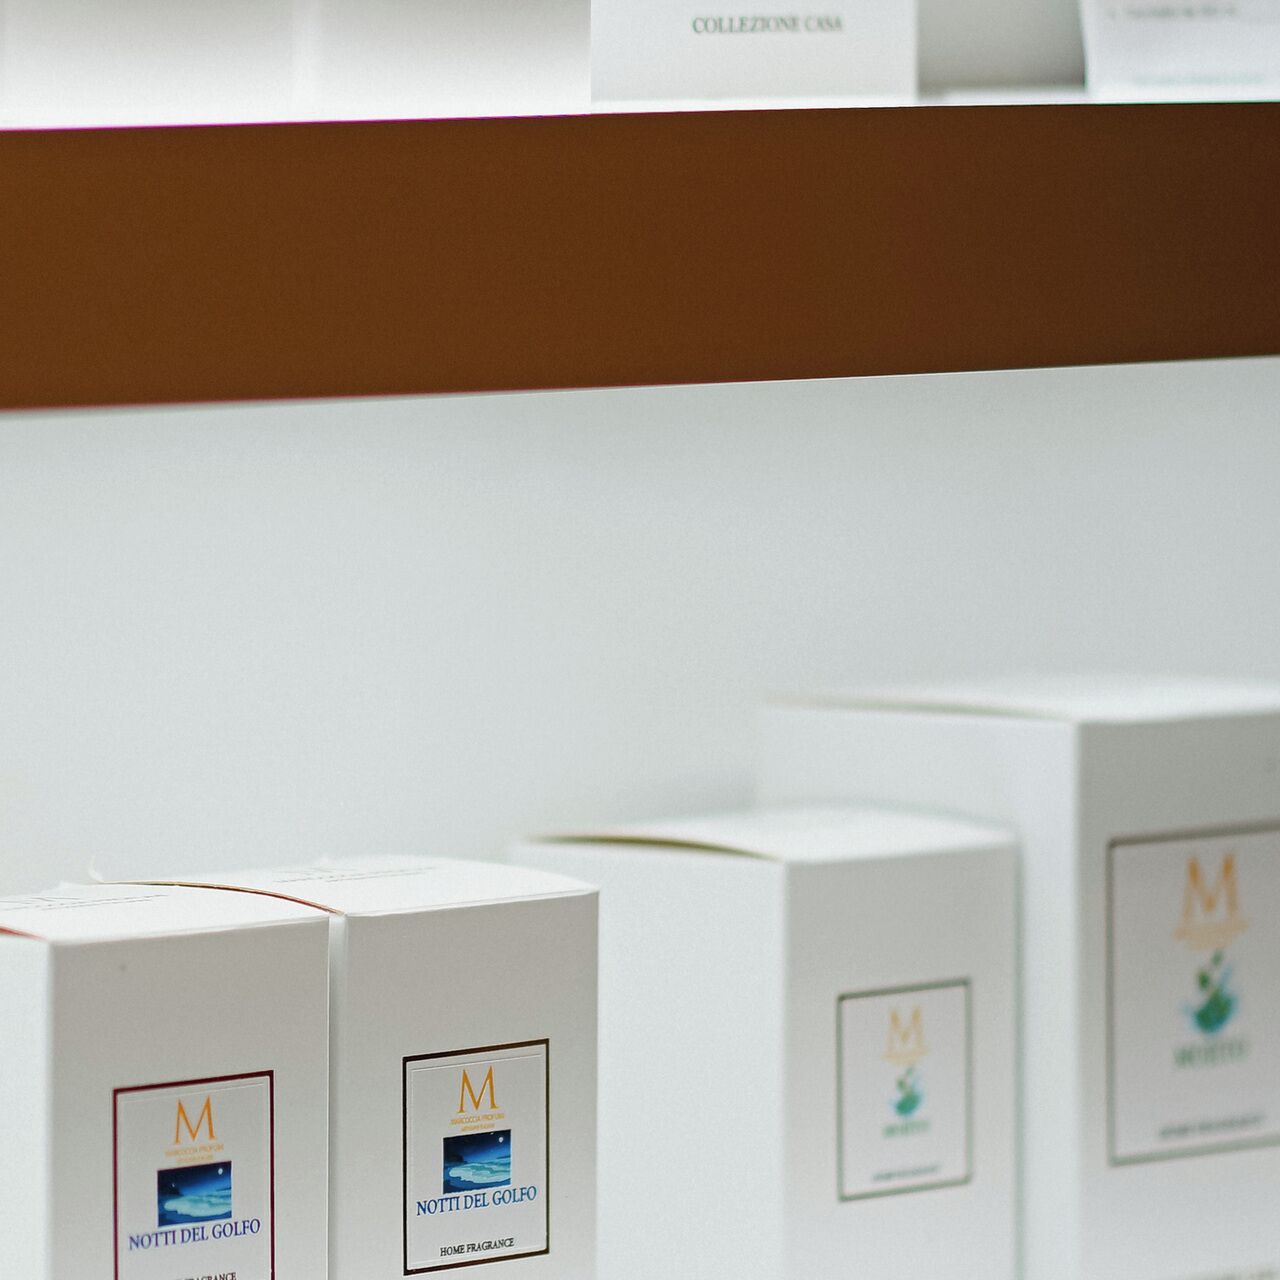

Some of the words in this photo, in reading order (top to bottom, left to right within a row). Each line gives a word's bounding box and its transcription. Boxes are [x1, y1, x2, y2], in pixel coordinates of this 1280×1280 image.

[691, 16, 800, 33] COLLEZIONE
[803, 15, 844, 32] CASA
[456, 1065, 500, 1113] M
[174, 1094, 217, 1145] M
[416, 1196, 460, 1217] NOTTI
[464, 1193, 489, 1210] DEL
[492, 1185, 537, 1206] GOLFO
[128, 1228, 176, 1251] NOTTI
[181, 1226, 209, 1245] DEL
[212, 1218, 261, 1240] GOLFO
[440, 1244, 465, 1257] HOME
[467, 1237, 515, 1254] FRAGRANCE
